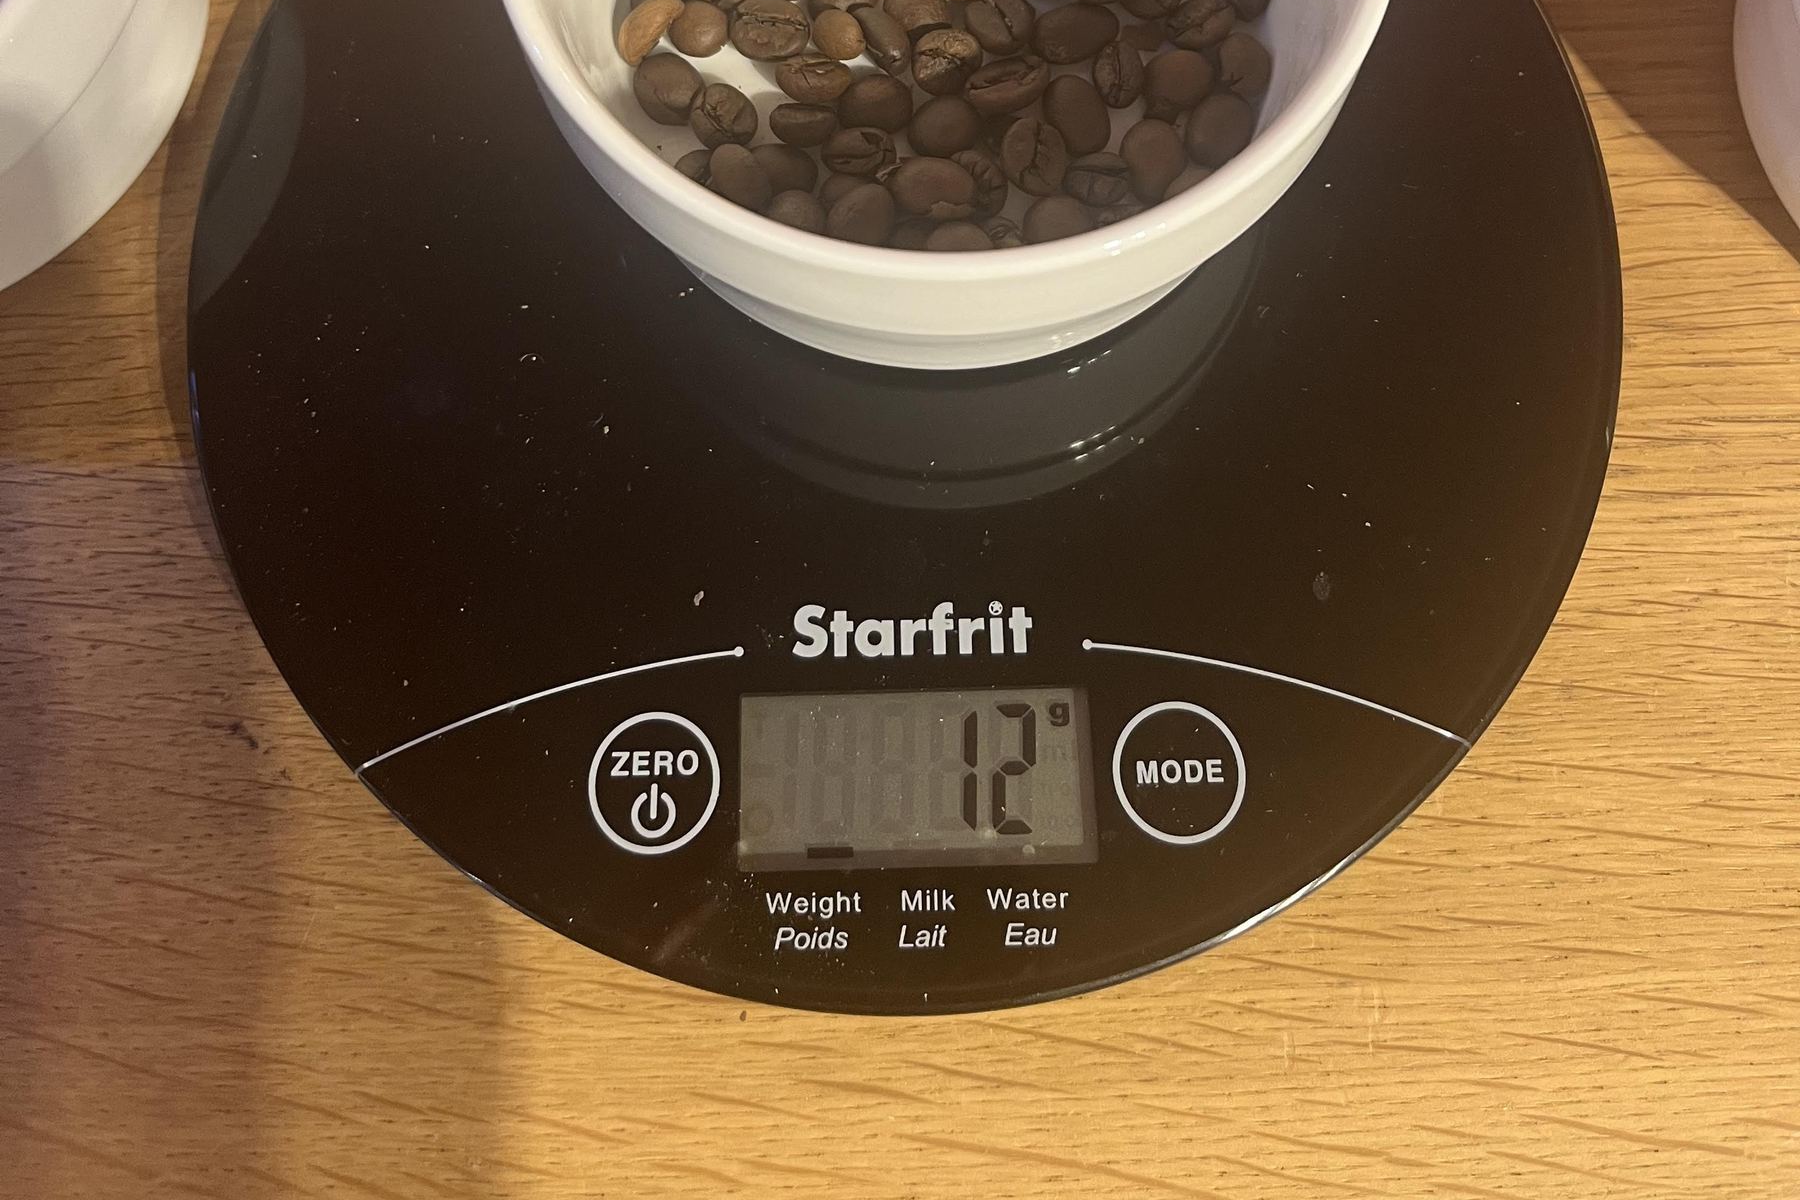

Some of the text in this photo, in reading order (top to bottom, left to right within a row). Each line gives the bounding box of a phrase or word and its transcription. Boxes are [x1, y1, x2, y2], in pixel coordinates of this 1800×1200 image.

[793, 601, 1032, 658] Starfrit
[611, 749, 699, 777] ZERO
[961, 703, 1036, 835] 12
[1136, 758, 1225, 786] MODE
[766, 891, 862, 919] Weight
[901, 889, 955, 912] Milk
[986, 887, 1069, 910] Water
[774, 926, 849, 951] Poids
[899, 925, 946, 949] Lait
[1005, 923, 1057, 946] Eau
